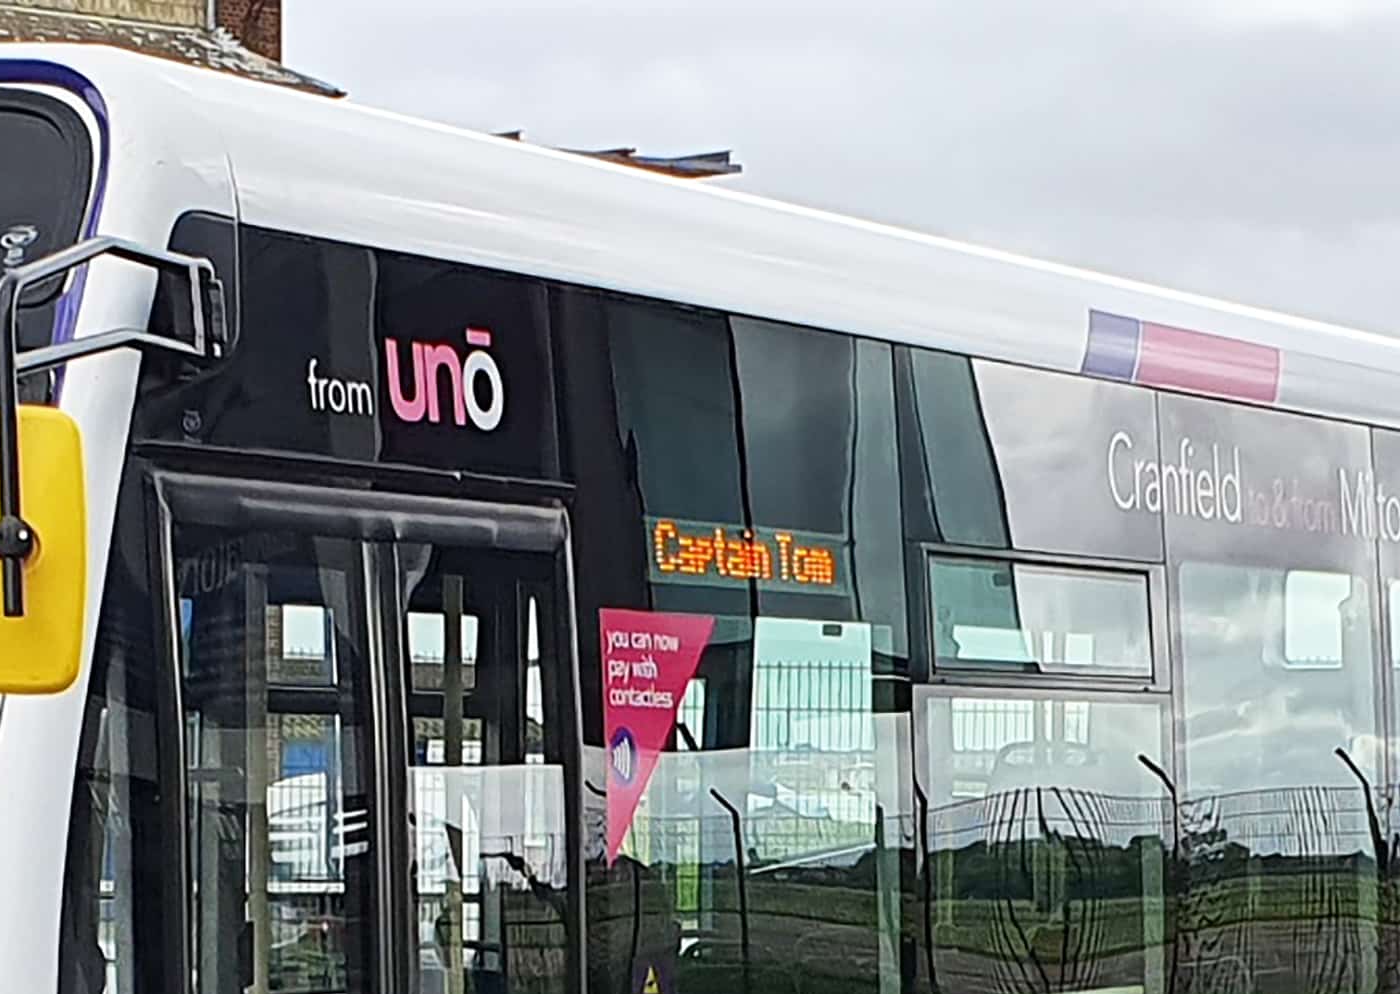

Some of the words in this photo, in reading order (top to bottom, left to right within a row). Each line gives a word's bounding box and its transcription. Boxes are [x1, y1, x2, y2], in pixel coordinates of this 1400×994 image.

[308, 358, 374, 416] from
[1108, 432, 1242, 523] Cranfield
[653, 520, 772, 580] Captain
[775, 531, 835, 586] Tom
[606, 630, 629, 654] you
[630, 632, 653, 650] can
[654, 634, 679, 652] now
[608, 660, 629, 685] pay
[632, 654, 658, 679] with
[610, 683, 674, 709] contactless
